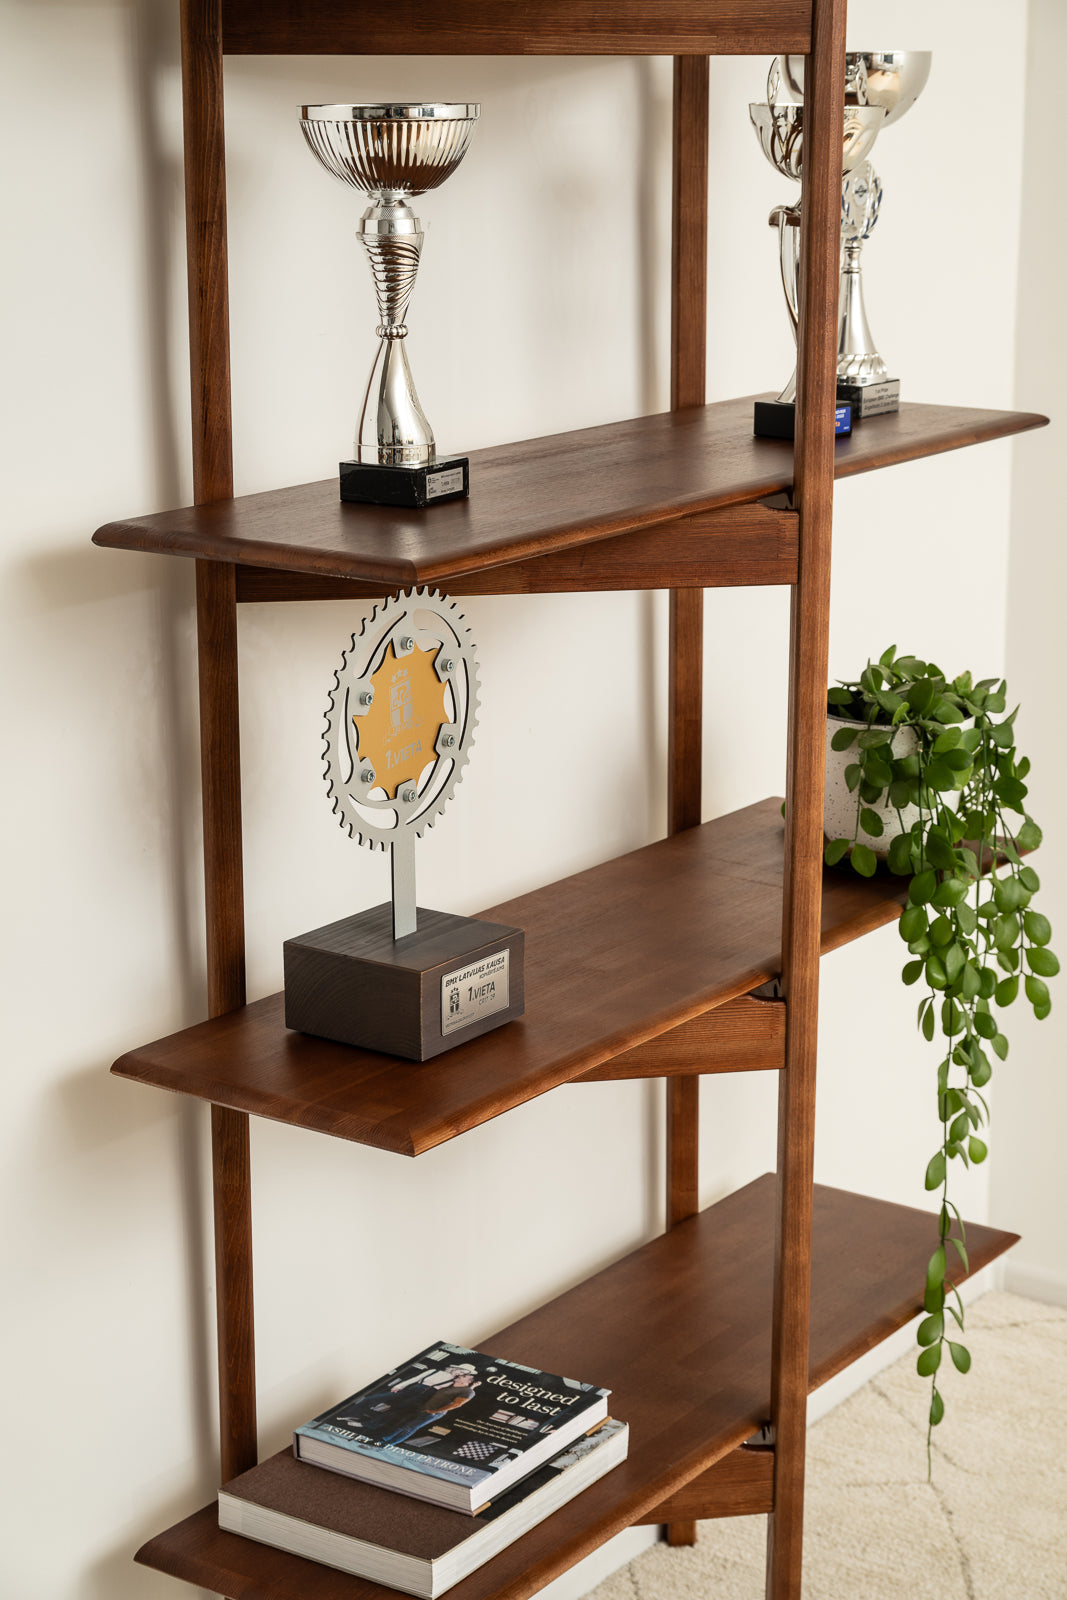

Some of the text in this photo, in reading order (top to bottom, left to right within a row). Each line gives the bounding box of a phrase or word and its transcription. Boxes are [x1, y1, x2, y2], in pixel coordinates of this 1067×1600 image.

[385, 739, 422, 770] 1.VIETA
[445, 956, 505, 987] BMX LATVIJAS KAUSA
[468, 981, 495, 1001] 1.VIETA
[486, 1374, 580, 1405] designed
[496, 1391, 563, 1417] to last
[325, 1425, 374, 1444] ASHLEY
[383, 1443, 416, 1458] DINO
[417, 1452, 477, 1476] PETRONE
